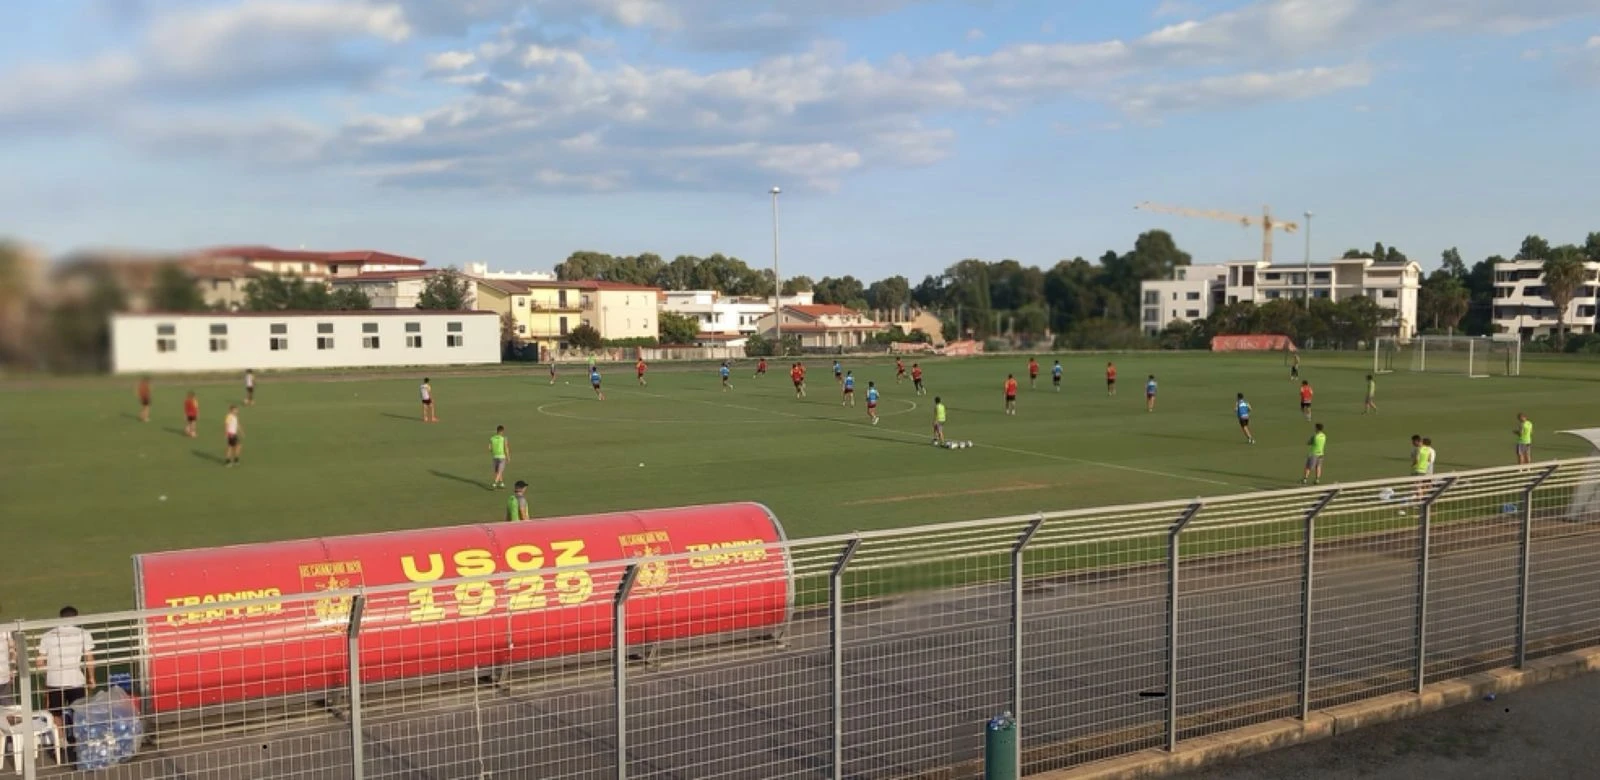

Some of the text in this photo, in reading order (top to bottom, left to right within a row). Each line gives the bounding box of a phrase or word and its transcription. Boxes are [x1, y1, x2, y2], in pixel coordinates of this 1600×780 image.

[401, 540, 590, 583] USCZ
[165, 587, 281, 609] TRAINING
[409, 570, 594, 622] 1929
